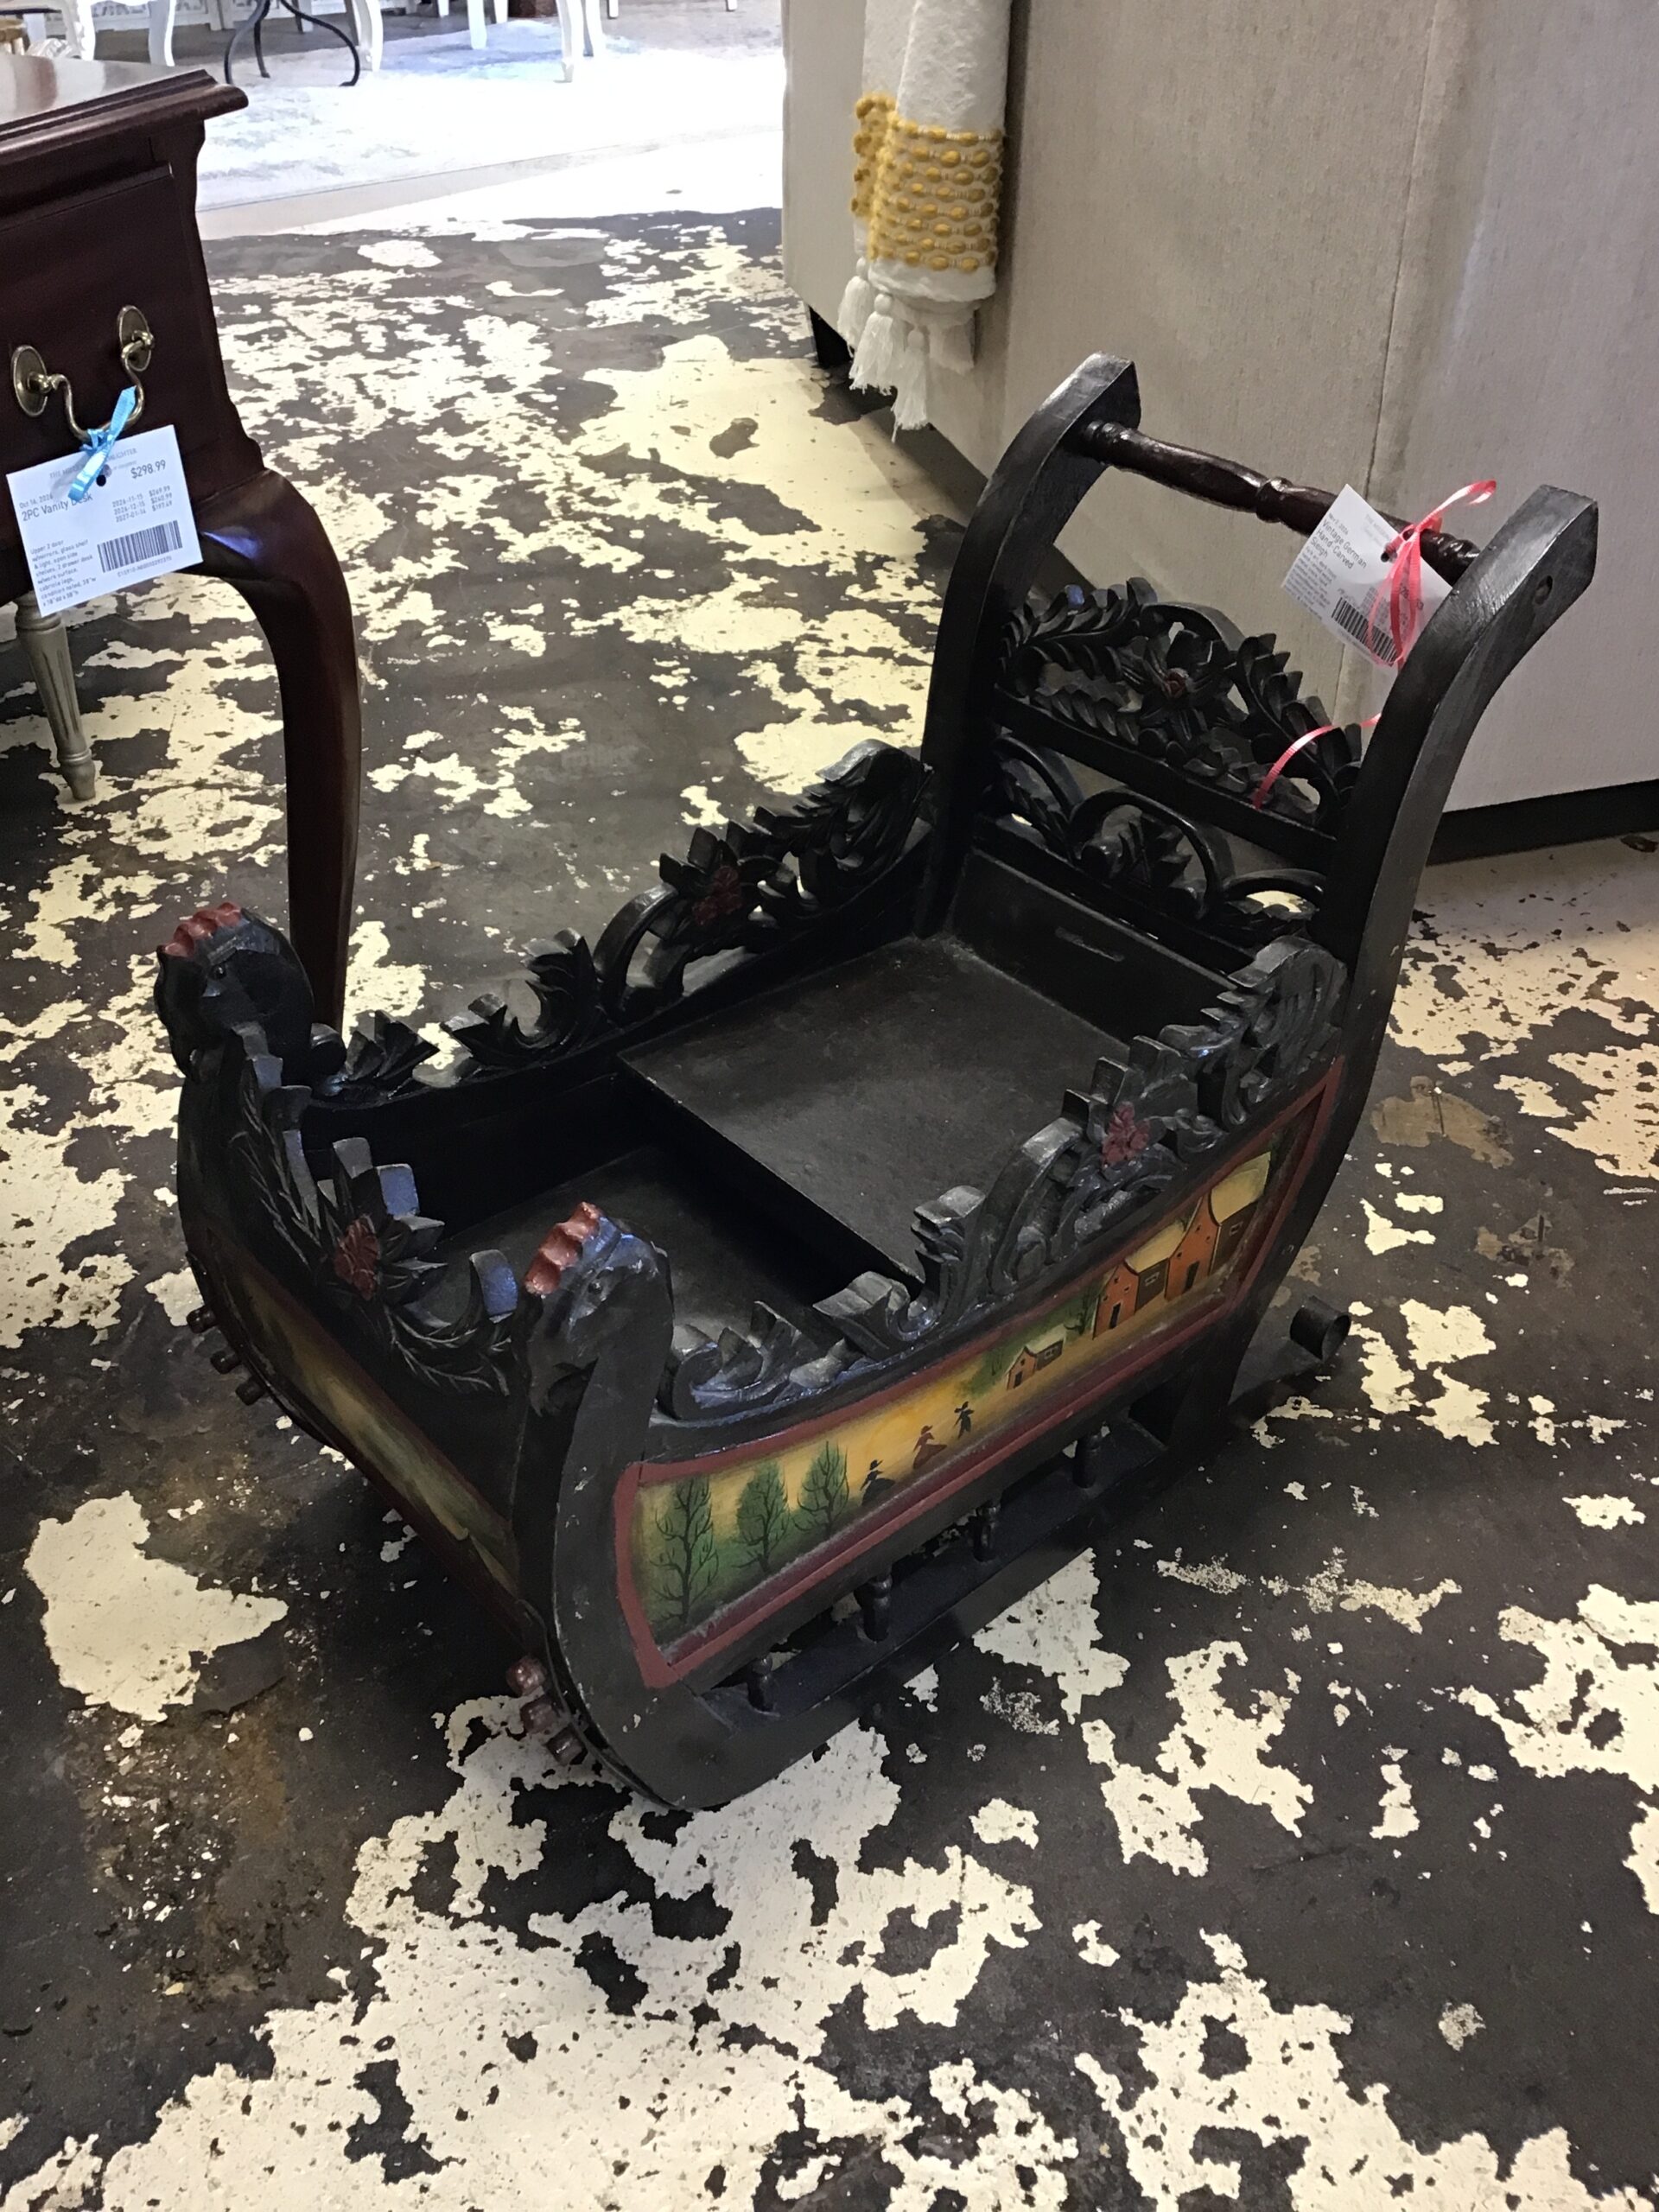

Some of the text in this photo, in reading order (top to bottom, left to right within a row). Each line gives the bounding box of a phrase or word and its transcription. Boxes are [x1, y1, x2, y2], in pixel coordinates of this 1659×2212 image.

[130, 460, 166, 479] $298.99
[22, 507, 40, 522] 2PC
[41, 500, 68, 514] Vanity
[1310, 537, 1328, 557] Sleigh
[1321, 521, 1344, 548] Vintage
[1343, 542, 1367, 569] German
